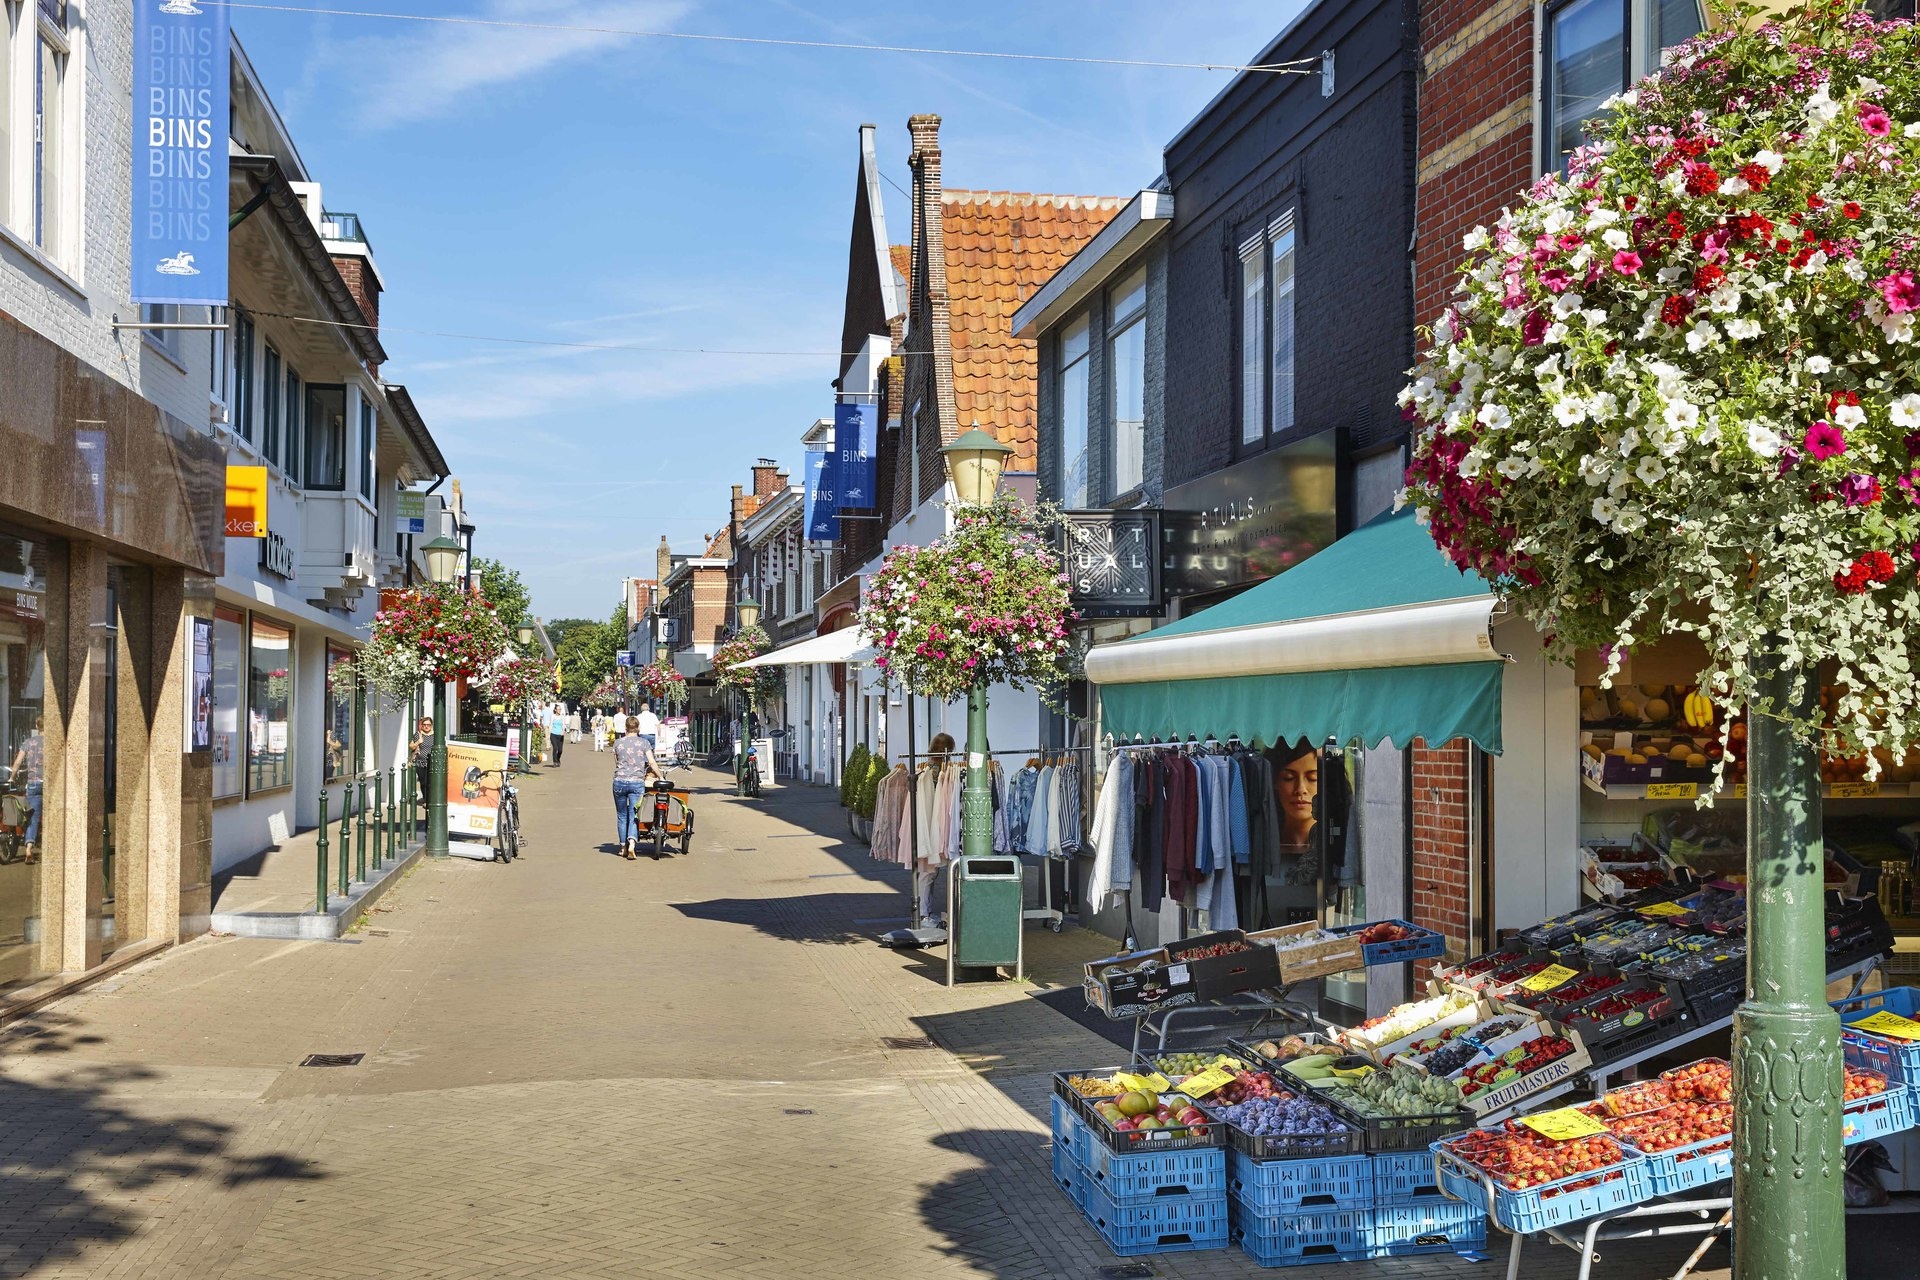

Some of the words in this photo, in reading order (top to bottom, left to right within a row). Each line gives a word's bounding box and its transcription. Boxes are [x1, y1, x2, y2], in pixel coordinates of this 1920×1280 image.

[151, 25, 212, 56] BINS
[151, 56, 212, 87] BINS
[150, 87, 212, 118] BINS
[149, 117, 212, 149] BINS
[149, 149, 211, 180] BINS
[149, 180, 211, 210] BINS
[148, 211, 211, 241] BINS
[842, 450, 867, 462] BINS
[811, 490, 833, 501] BINS
[1484, 1060, 1570, 1111] FRUITMASTERS
